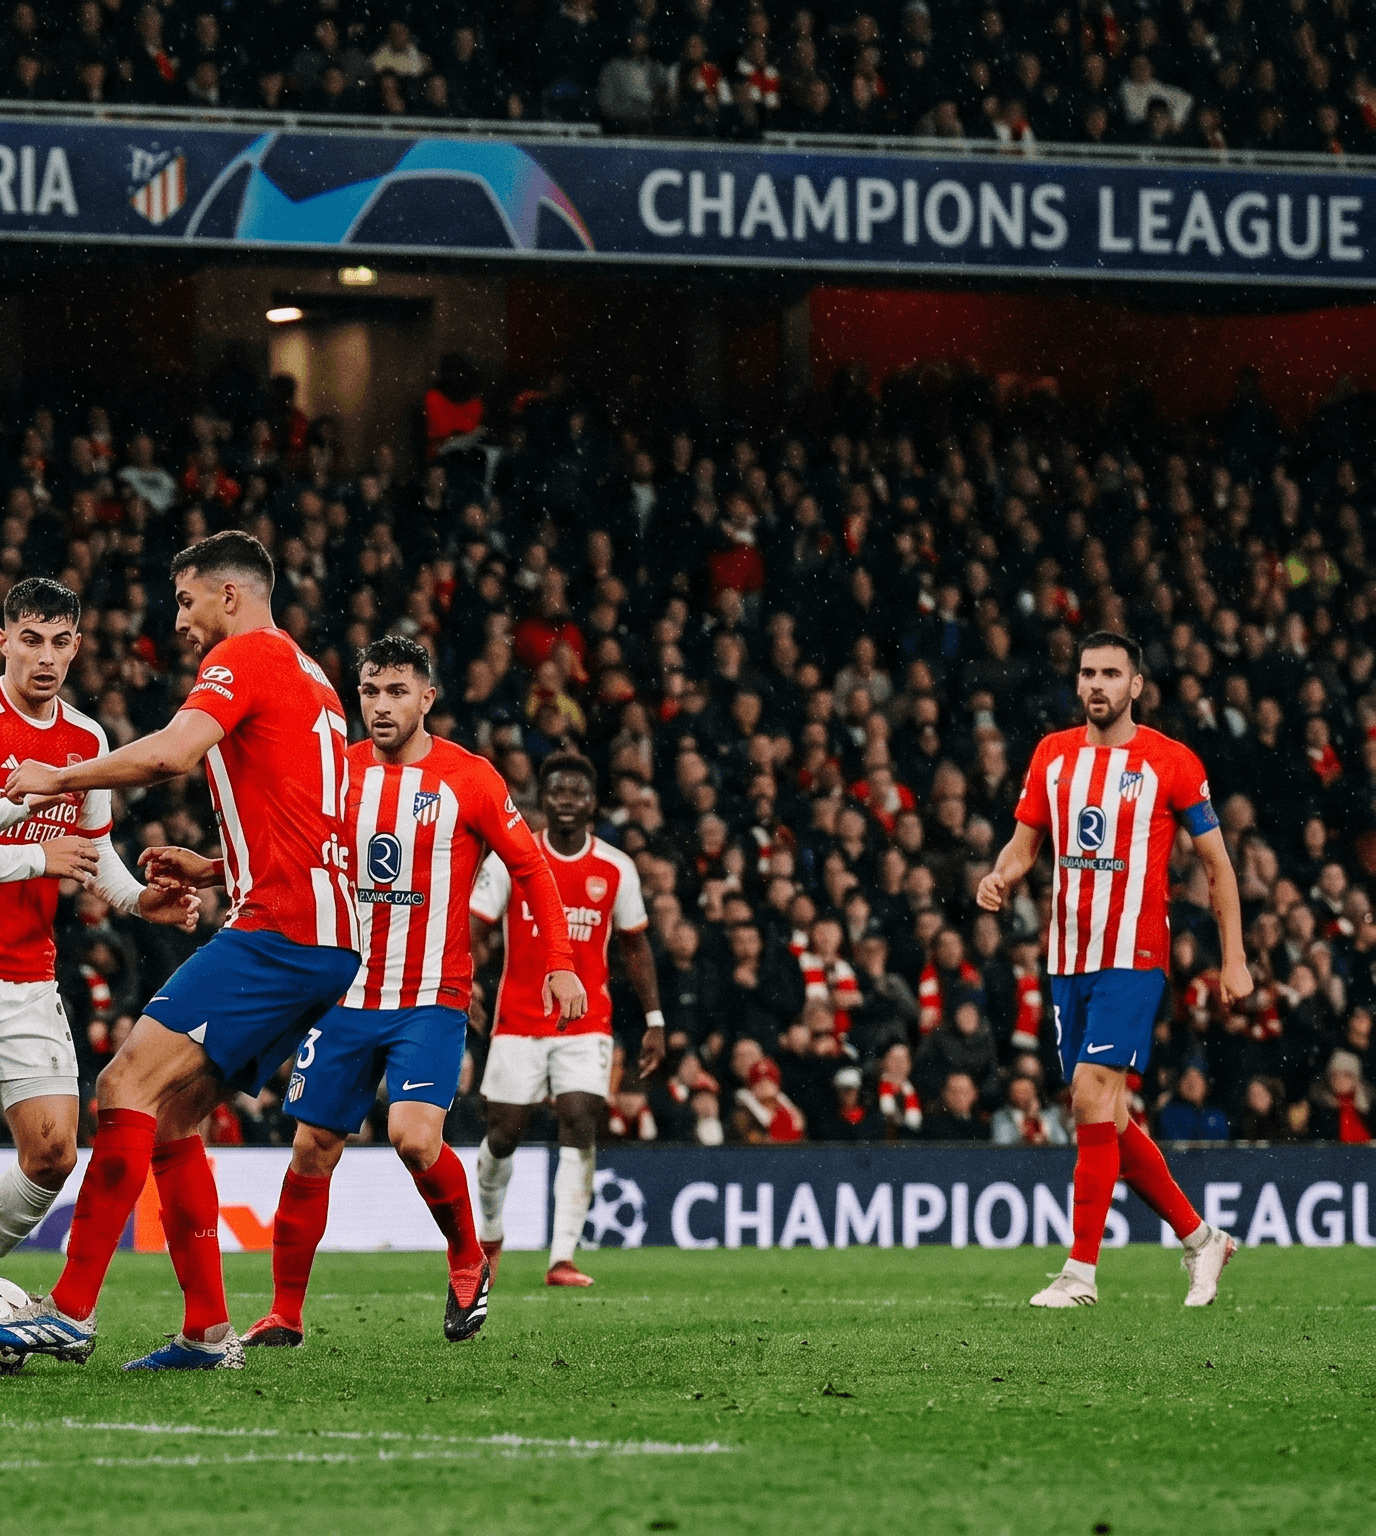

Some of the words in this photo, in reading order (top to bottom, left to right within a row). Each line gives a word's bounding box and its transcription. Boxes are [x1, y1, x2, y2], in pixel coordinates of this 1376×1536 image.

[638, 168, 1068, 251] CHAMPIONS
[1097, 185, 1364, 261] LEAGUE
[296, 1027, 323, 1070] 3
[1161, 1180, 1376, 1248] EAG
